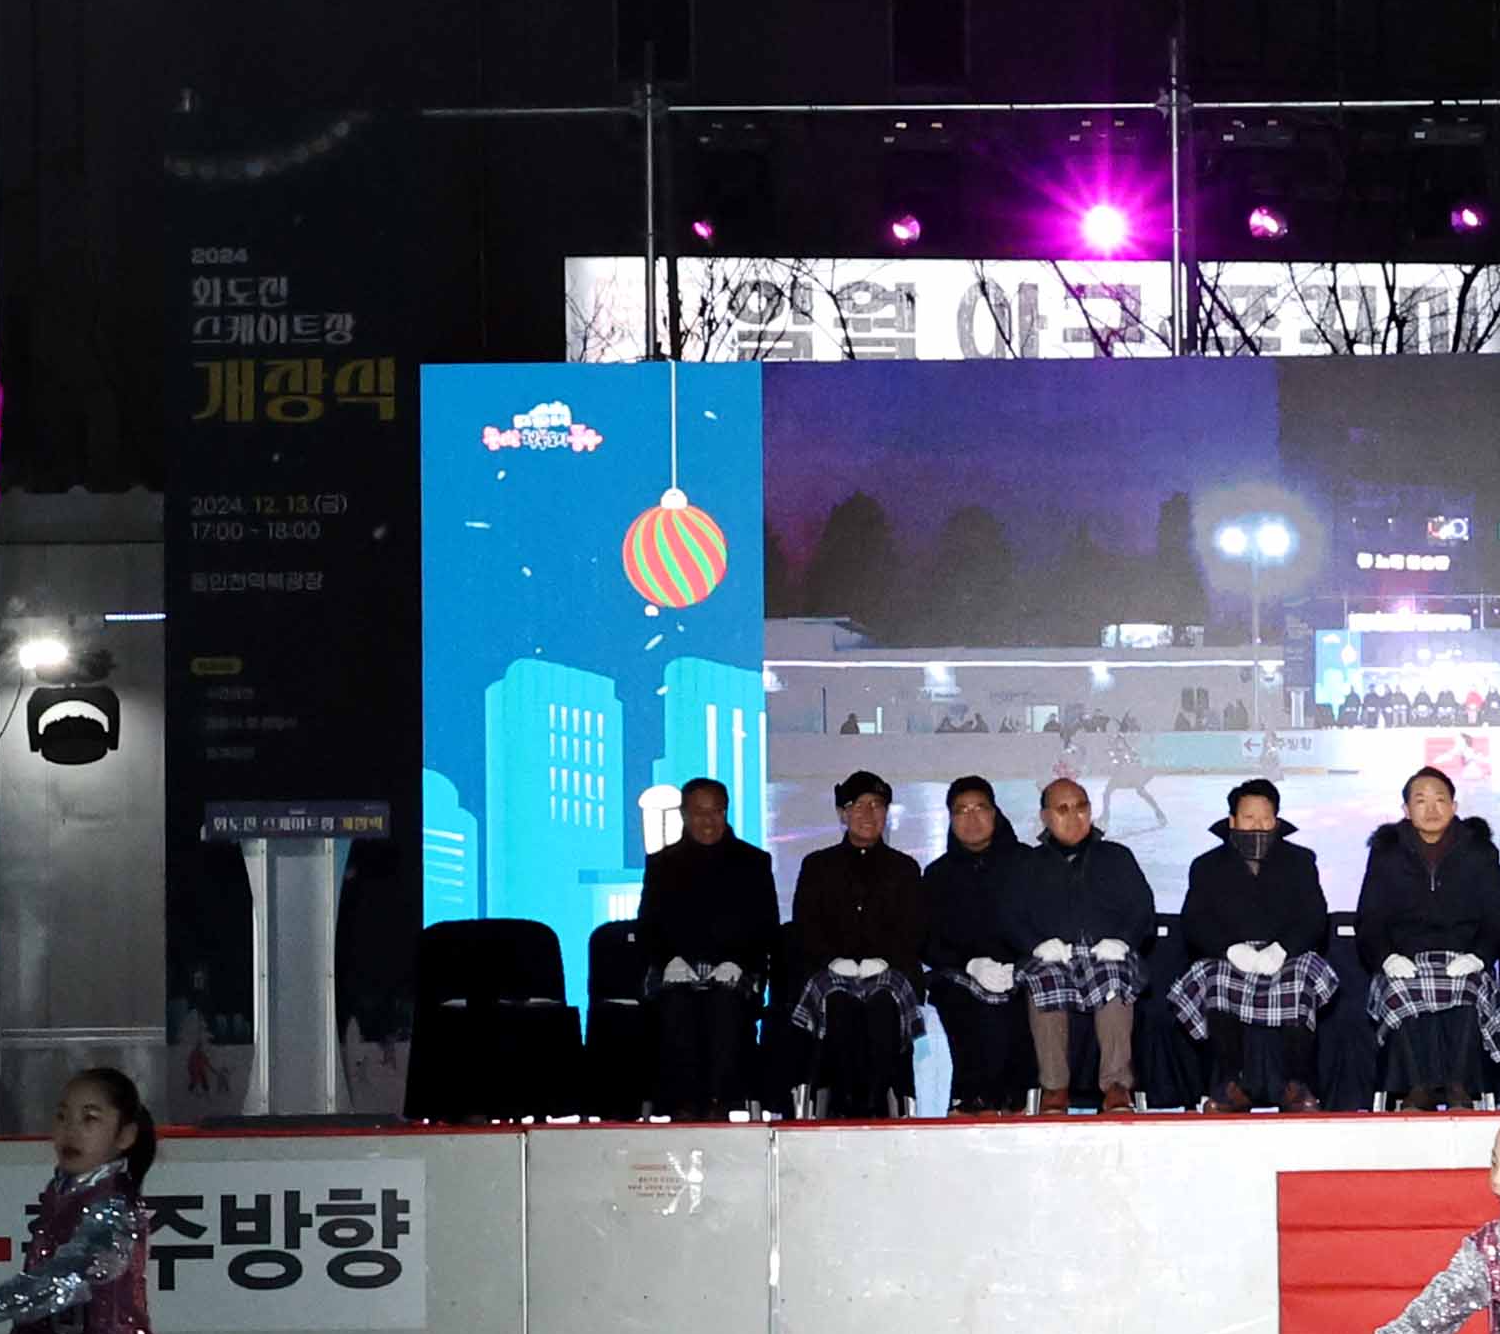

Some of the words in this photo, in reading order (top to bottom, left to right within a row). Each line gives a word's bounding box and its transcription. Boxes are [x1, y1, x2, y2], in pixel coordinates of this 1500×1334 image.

[191, 275, 289, 308] 화도진
[191, 312, 356, 345] 스케이트장
[190, 356, 396, 424] 개장식
[23, 1188, 410, 1290] 주방향
